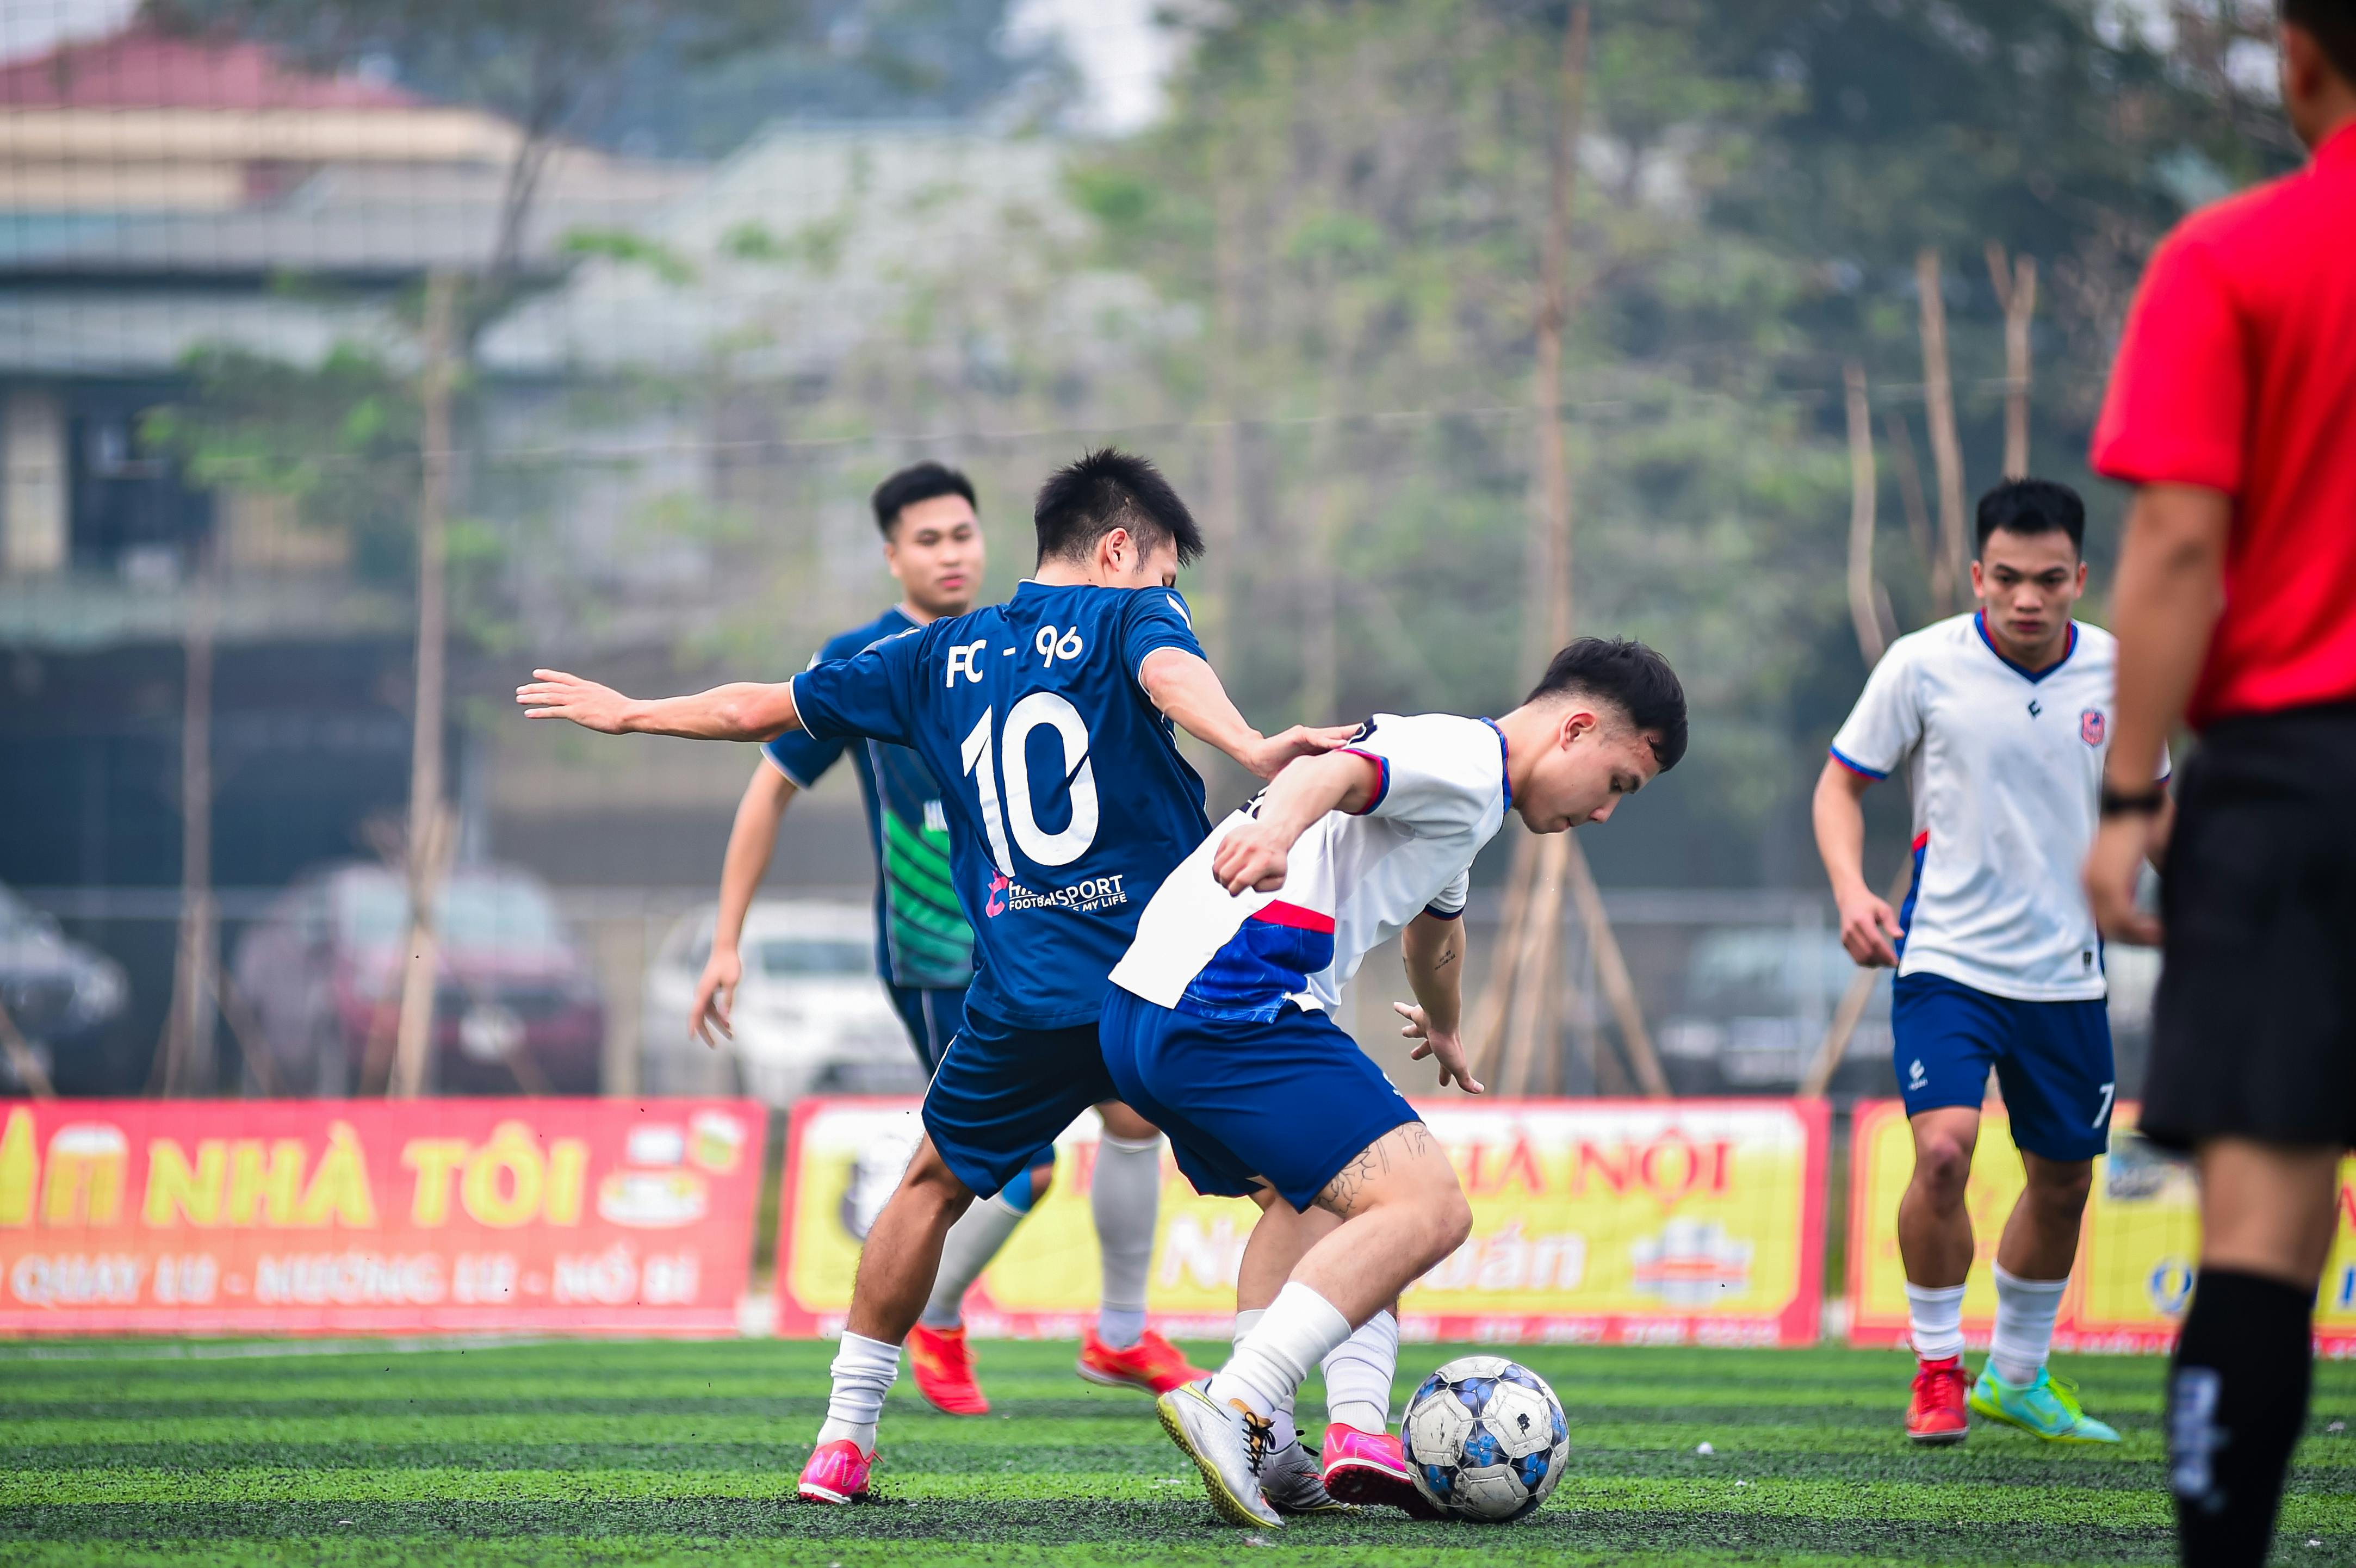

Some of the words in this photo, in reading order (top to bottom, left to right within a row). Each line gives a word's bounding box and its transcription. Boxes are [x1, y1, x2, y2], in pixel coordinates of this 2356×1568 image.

[946, 639, 987, 688] FC
[1036, 625, 1083, 668] 96
[960, 691, 1099, 878] 10
[1082, 900, 1099, 912] MY
[1101, 894, 1127, 907] LIFE
[2092, 1082, 2115, 1129] 7
[142, 1121, 379, 1229] NHÀ
[400, 1118, 591, 1229] TÔI
